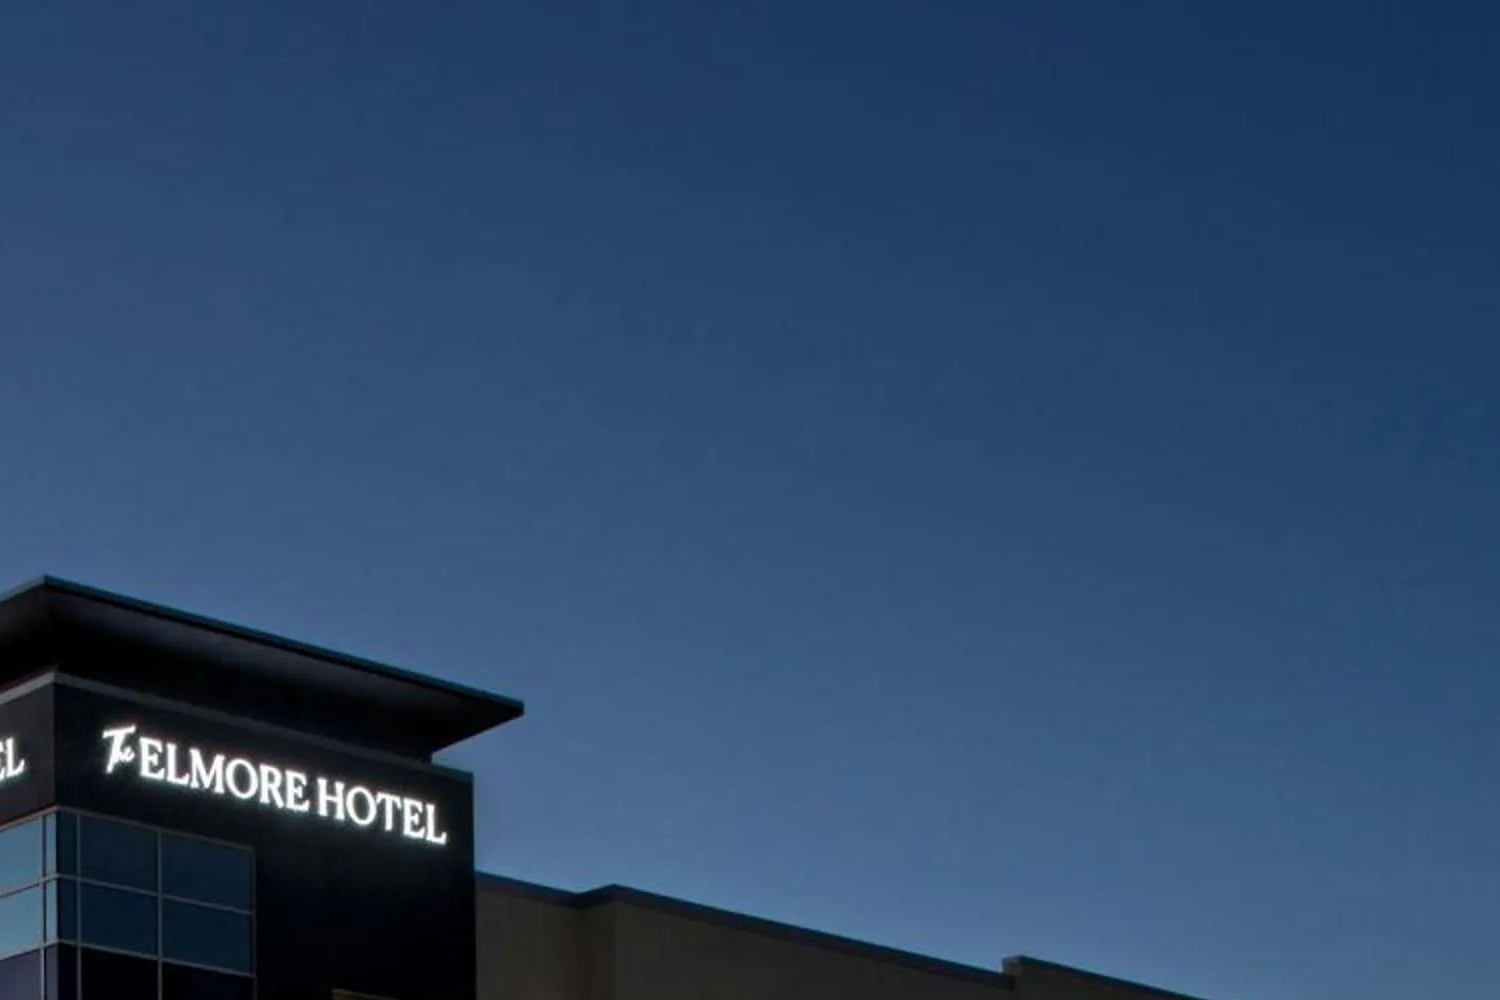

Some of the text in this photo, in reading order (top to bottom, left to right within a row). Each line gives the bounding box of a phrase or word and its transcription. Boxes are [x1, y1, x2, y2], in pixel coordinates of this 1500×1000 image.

[102, 725, 447, 846] The ELMORE HOTEL
